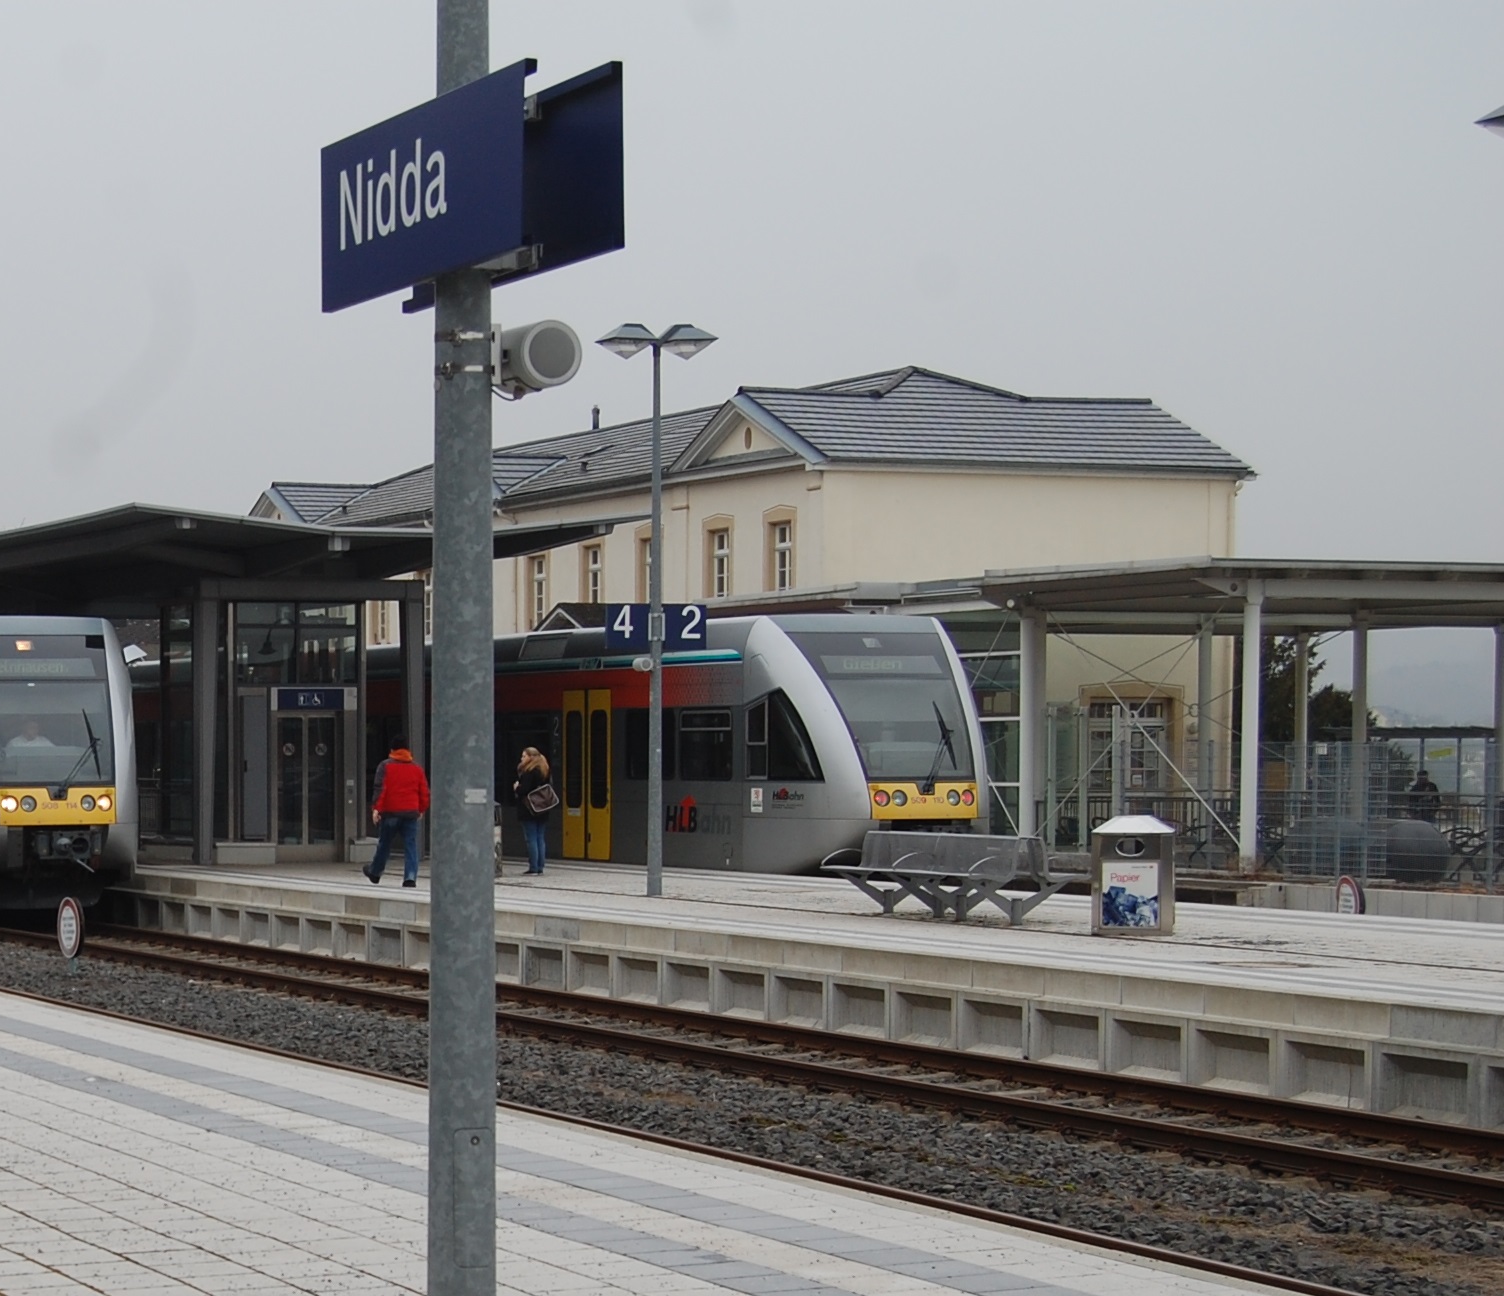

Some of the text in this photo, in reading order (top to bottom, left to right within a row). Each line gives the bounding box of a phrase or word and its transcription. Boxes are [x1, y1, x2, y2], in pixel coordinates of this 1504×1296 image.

[339, 137, 447, 251] Nidda
[613, 604, 702, 639] 4 2
[1110, 872, 1140, 883] Papier
